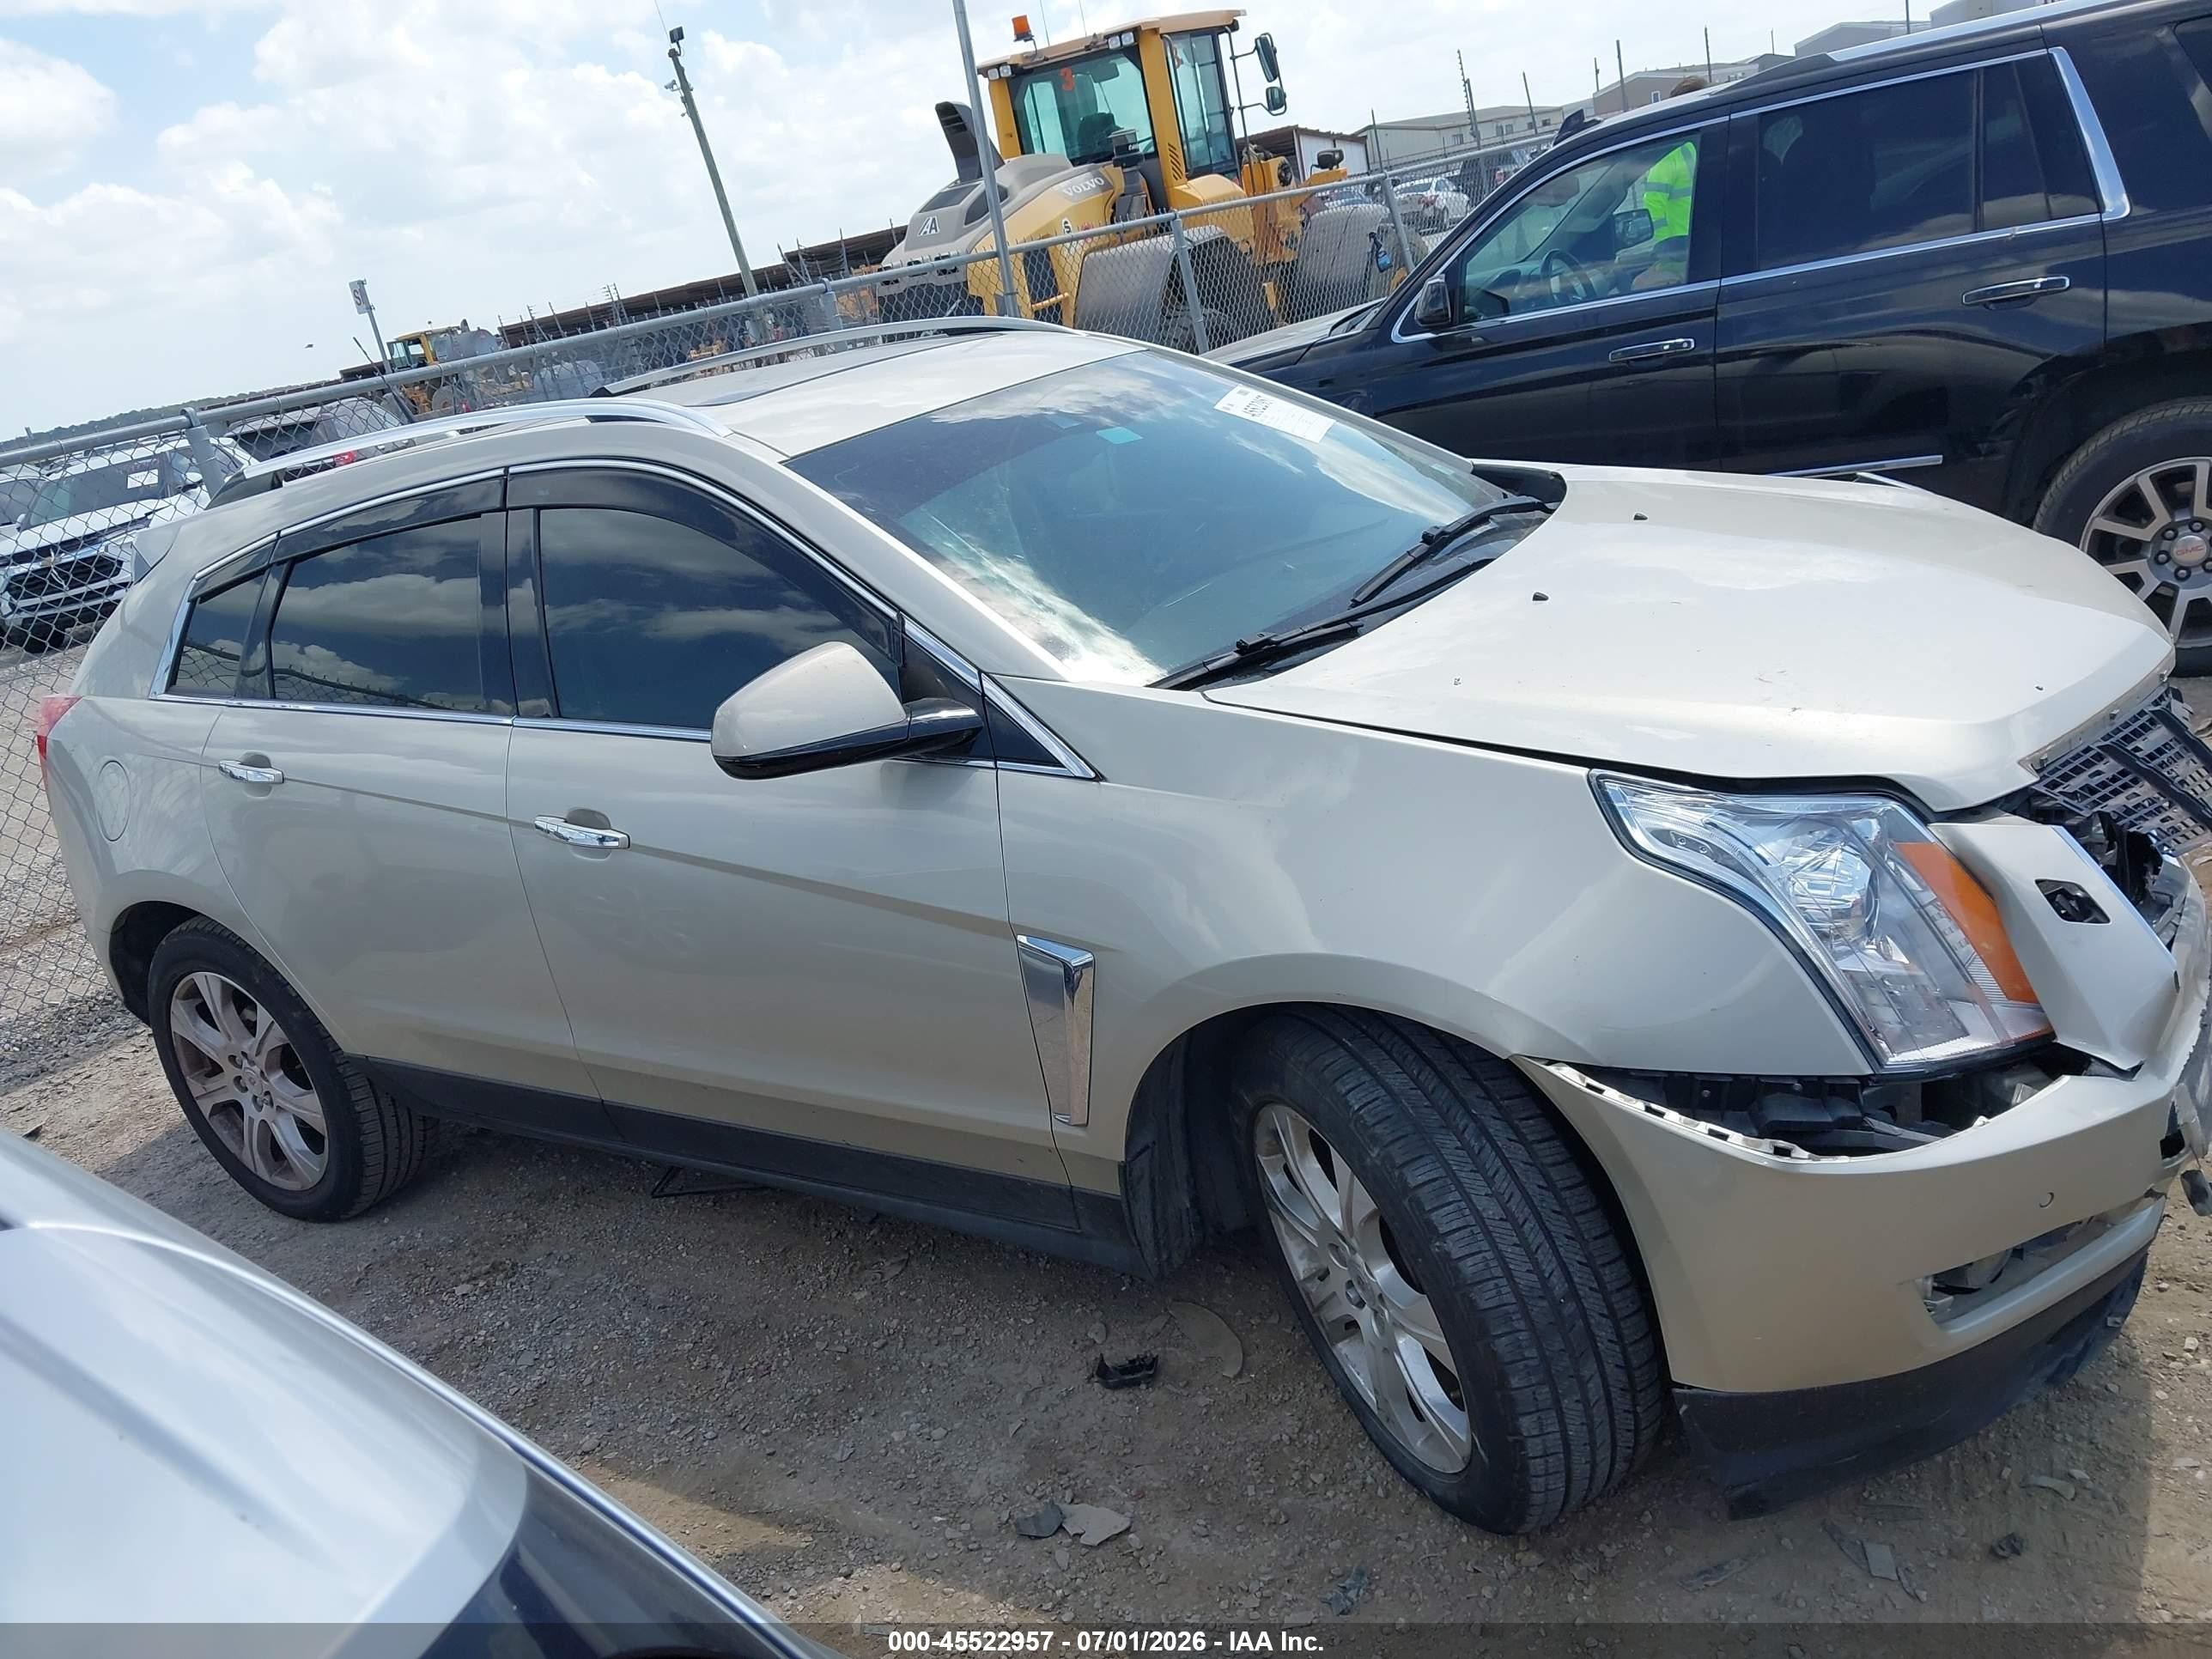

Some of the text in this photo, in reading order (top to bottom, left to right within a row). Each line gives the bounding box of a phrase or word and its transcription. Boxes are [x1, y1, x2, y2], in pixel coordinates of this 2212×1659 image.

[1060, 67, 1075, 91] 3
[1064, 177, 1105, 196] VOLVO
[2176, 544, 2204, 556] GMC
